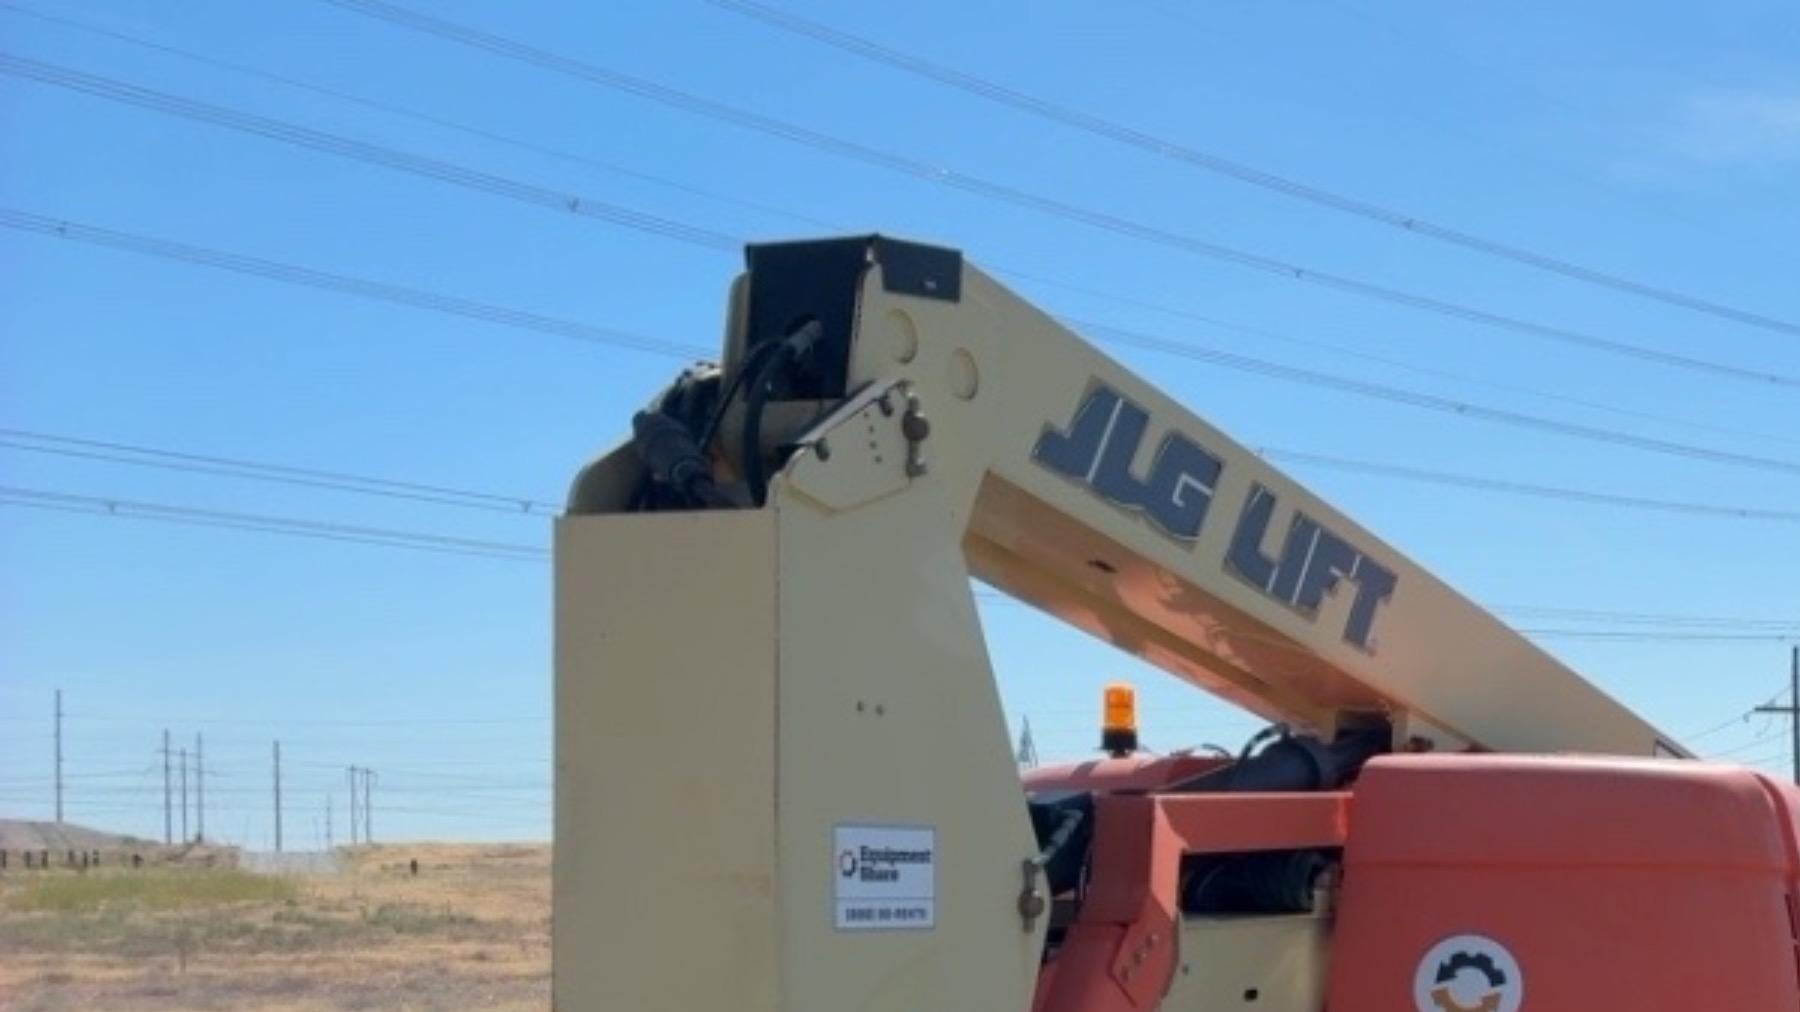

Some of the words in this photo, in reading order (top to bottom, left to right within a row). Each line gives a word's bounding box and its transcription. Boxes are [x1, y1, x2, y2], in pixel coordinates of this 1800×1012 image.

[1030, 374, 1224, 553] JLG
[1222, 480, 1399, 655] LIFT
[860, 845, 931, 867] Equipment
[860, 866, 899, 882] Share
